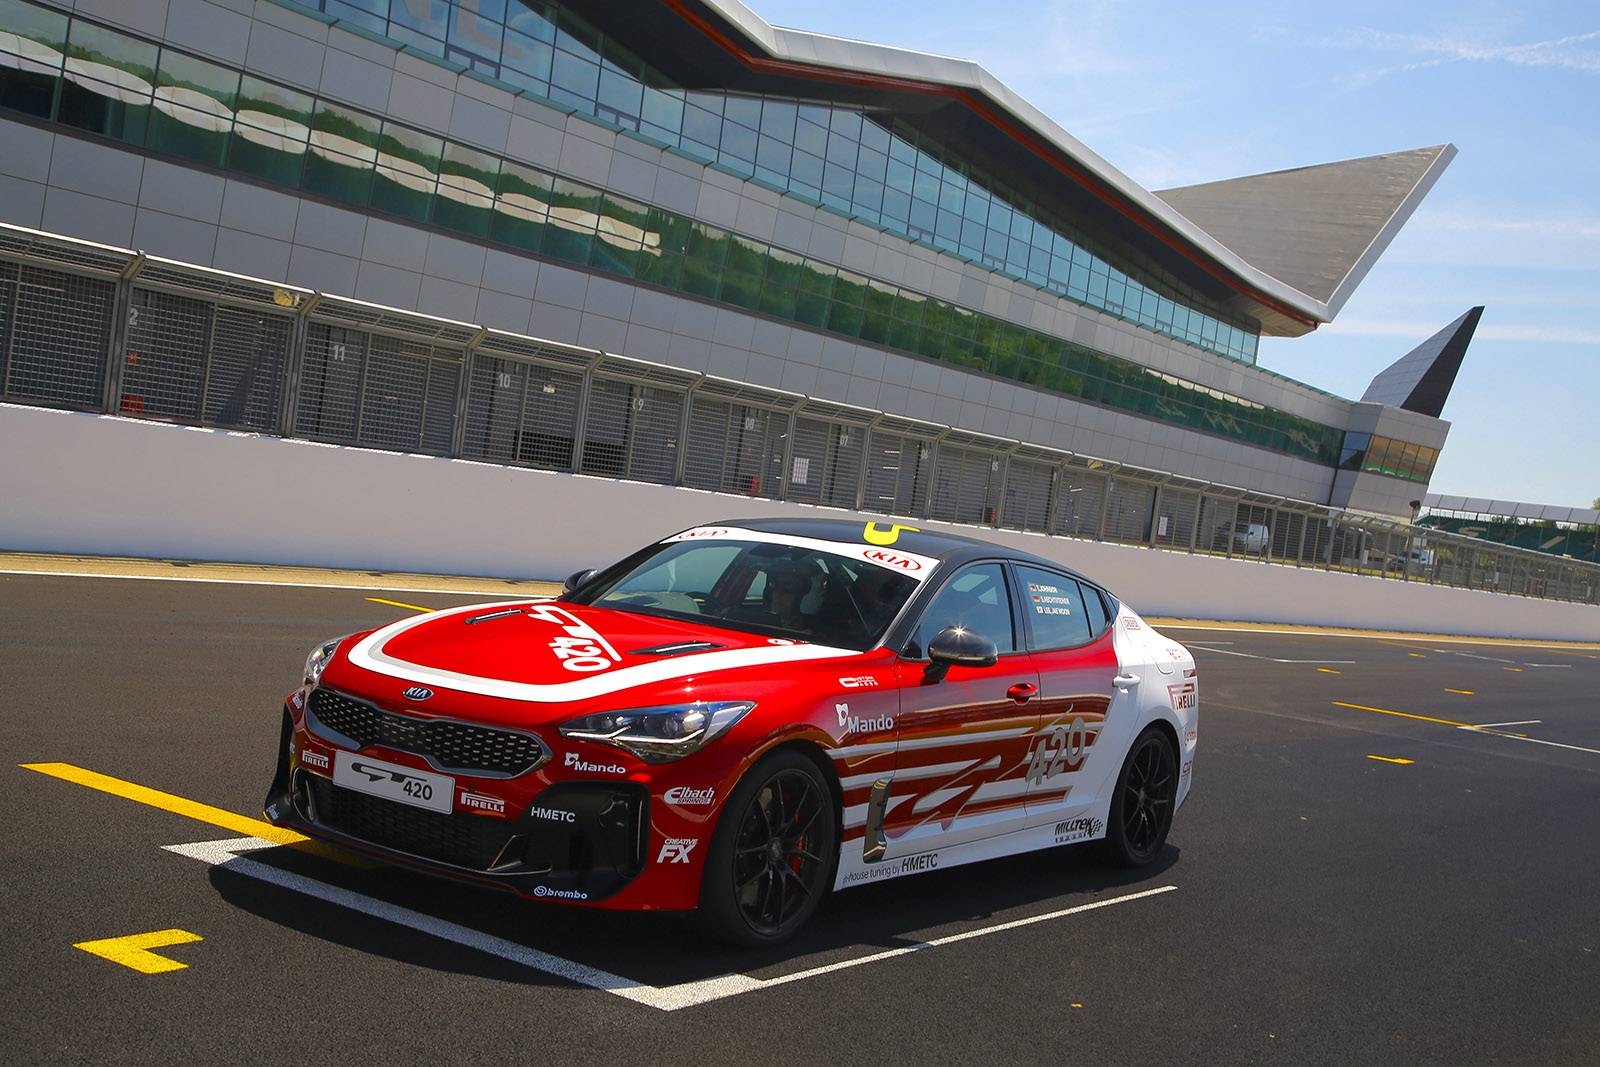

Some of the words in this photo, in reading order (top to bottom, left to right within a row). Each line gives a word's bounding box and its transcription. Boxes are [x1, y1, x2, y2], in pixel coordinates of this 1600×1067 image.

[333, 344, 346, 362] 11
[499, 373, 511, 388] 10
[548, 636, 612, 672] 420
[847, 713, 894, 734] Mando
[302, 750, 329, 769] PIRELLI
[1025, 716, 1086, 786] 420
[574, 760, 627, 774] Mando
[402, 780, 433, 801] 420
[460, 791, 505, 813] PIRELLI
[530, 806, 576, 823] HMETC
[656, 843, 697, 864] FX
[902, 853, 938, 872] HMETC
[547, 887, 589, 900] brembo
